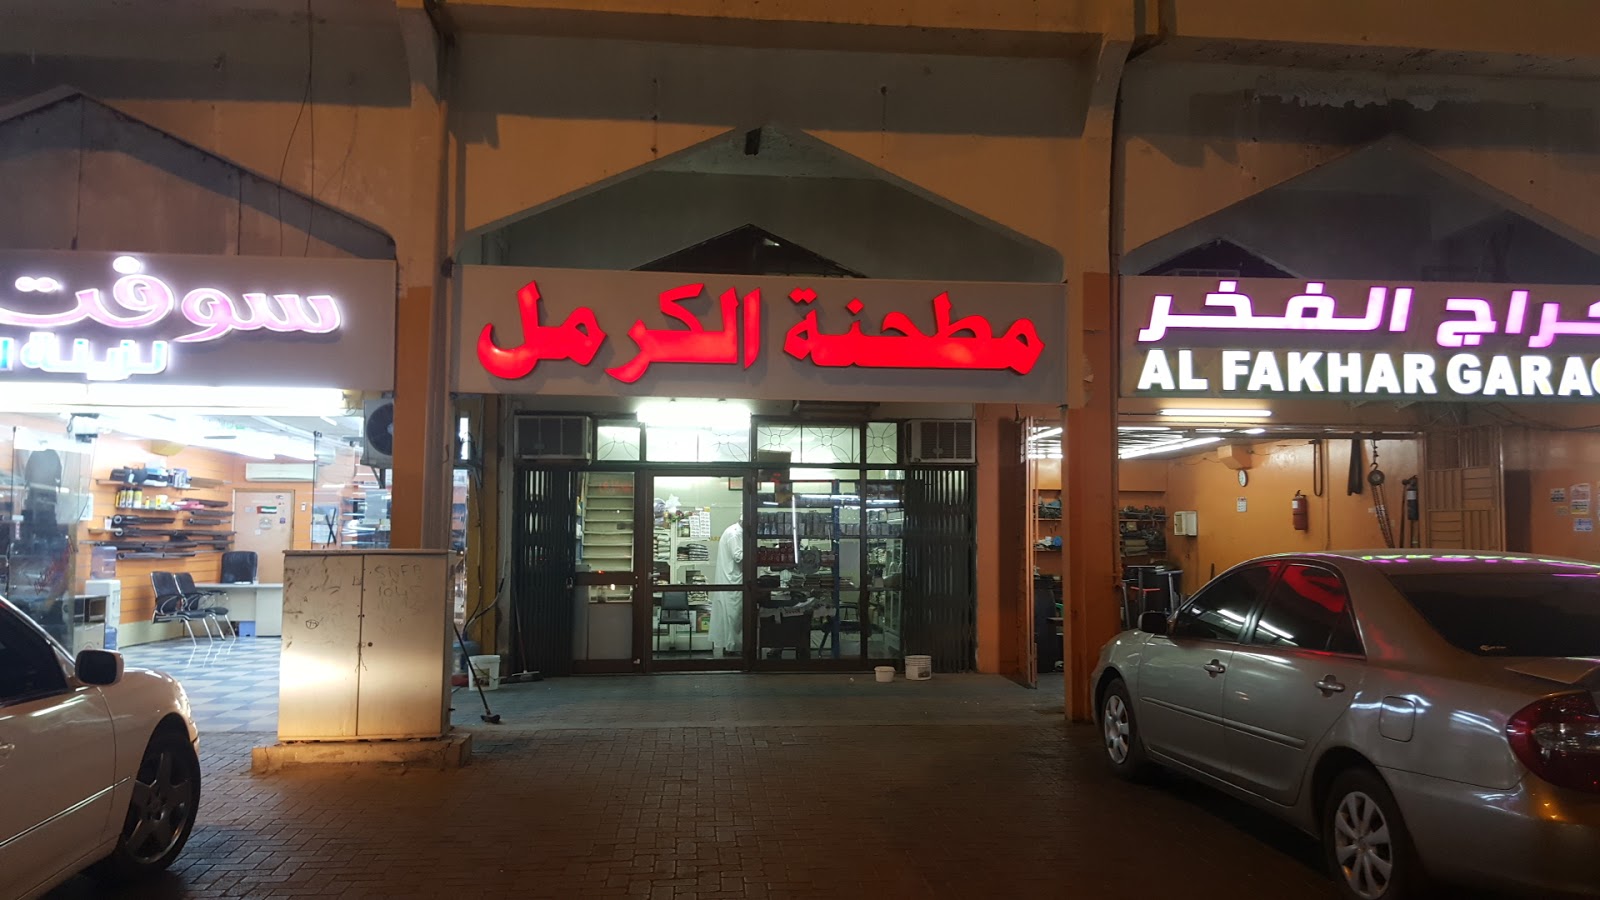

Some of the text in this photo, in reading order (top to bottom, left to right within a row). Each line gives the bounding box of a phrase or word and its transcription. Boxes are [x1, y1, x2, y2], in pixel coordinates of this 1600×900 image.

[477, 280, 1045, 383] مطحنة الكرمل
[1137, 280, 1413, 342] الفخر
[1137, 349, 1600, 396] AL FAKHAR GARA
